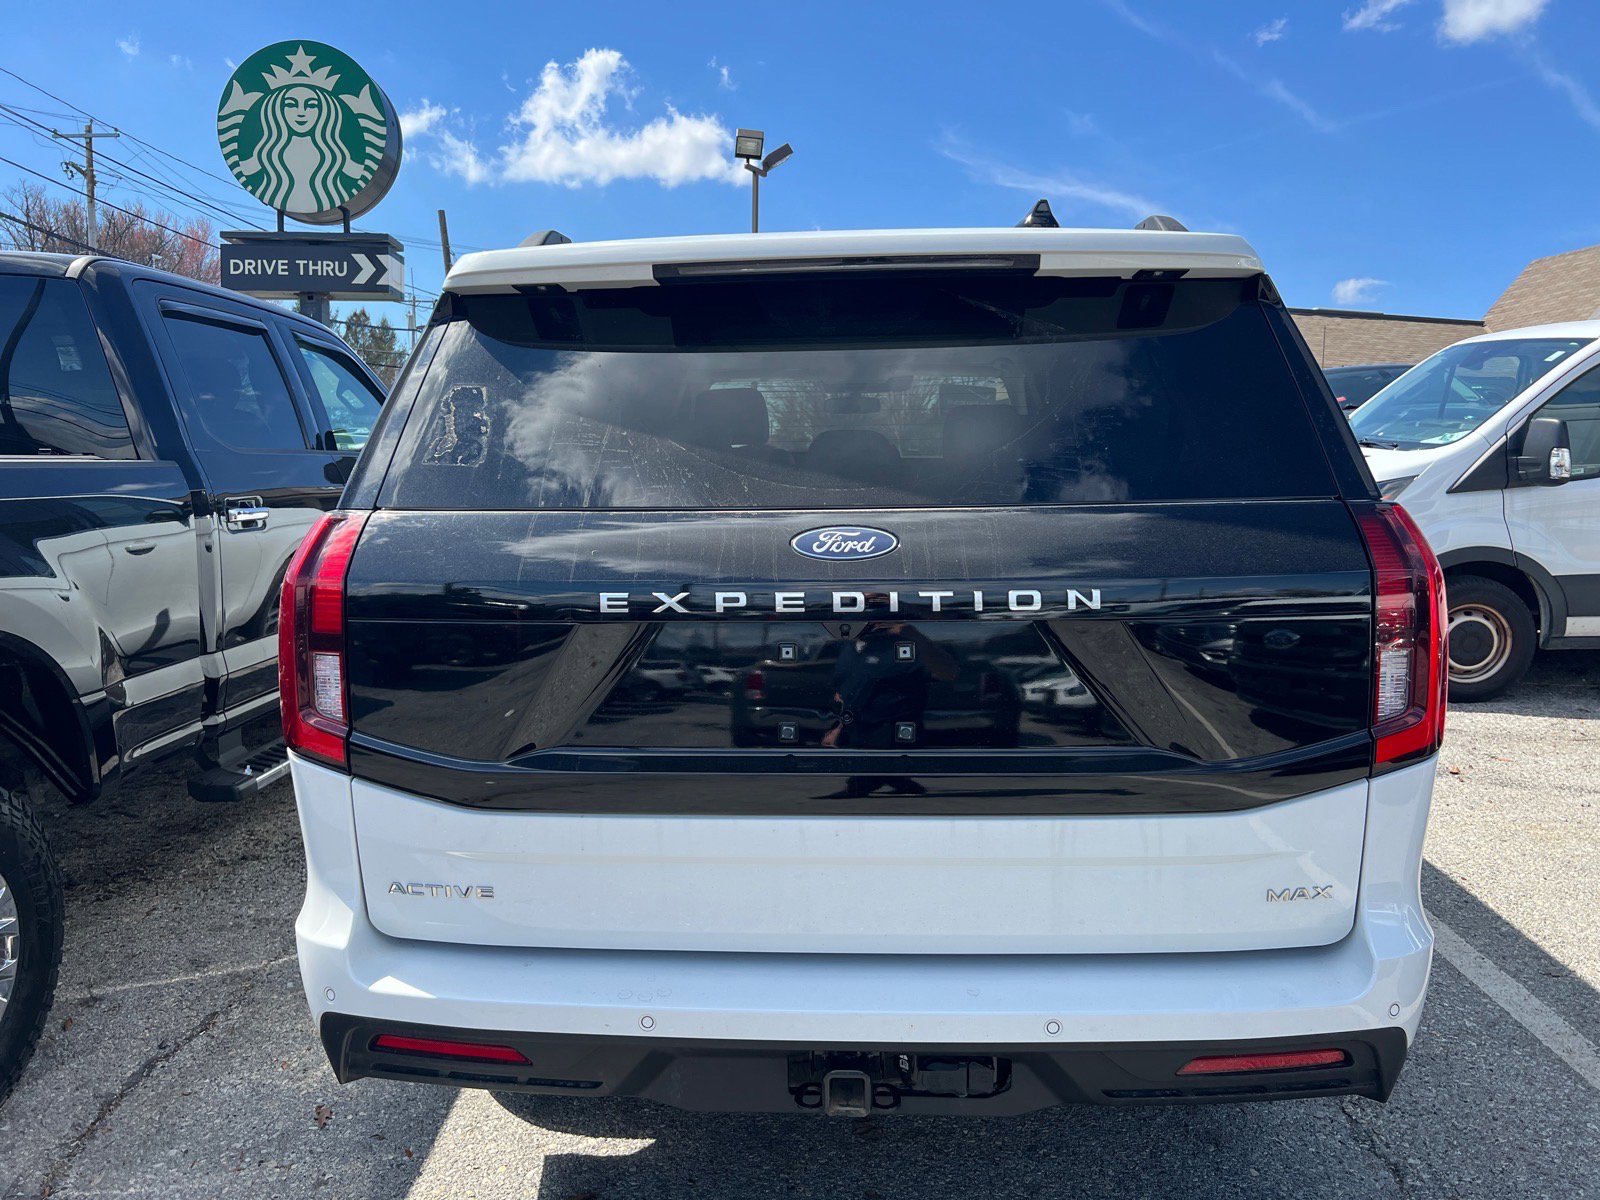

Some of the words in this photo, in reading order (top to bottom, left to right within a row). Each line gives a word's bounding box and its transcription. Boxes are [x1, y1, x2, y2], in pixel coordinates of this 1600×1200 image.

[229, 259, 289, 275] DRIVE
[296, 260, 348, 277] THRU
[812, 531, 876, 553] Ford
[599, 588, 1101, 613] EXPEDITION
[388, 881, 494, 899] ACTIVE
[1265, 884, 1333, 902] MAX
